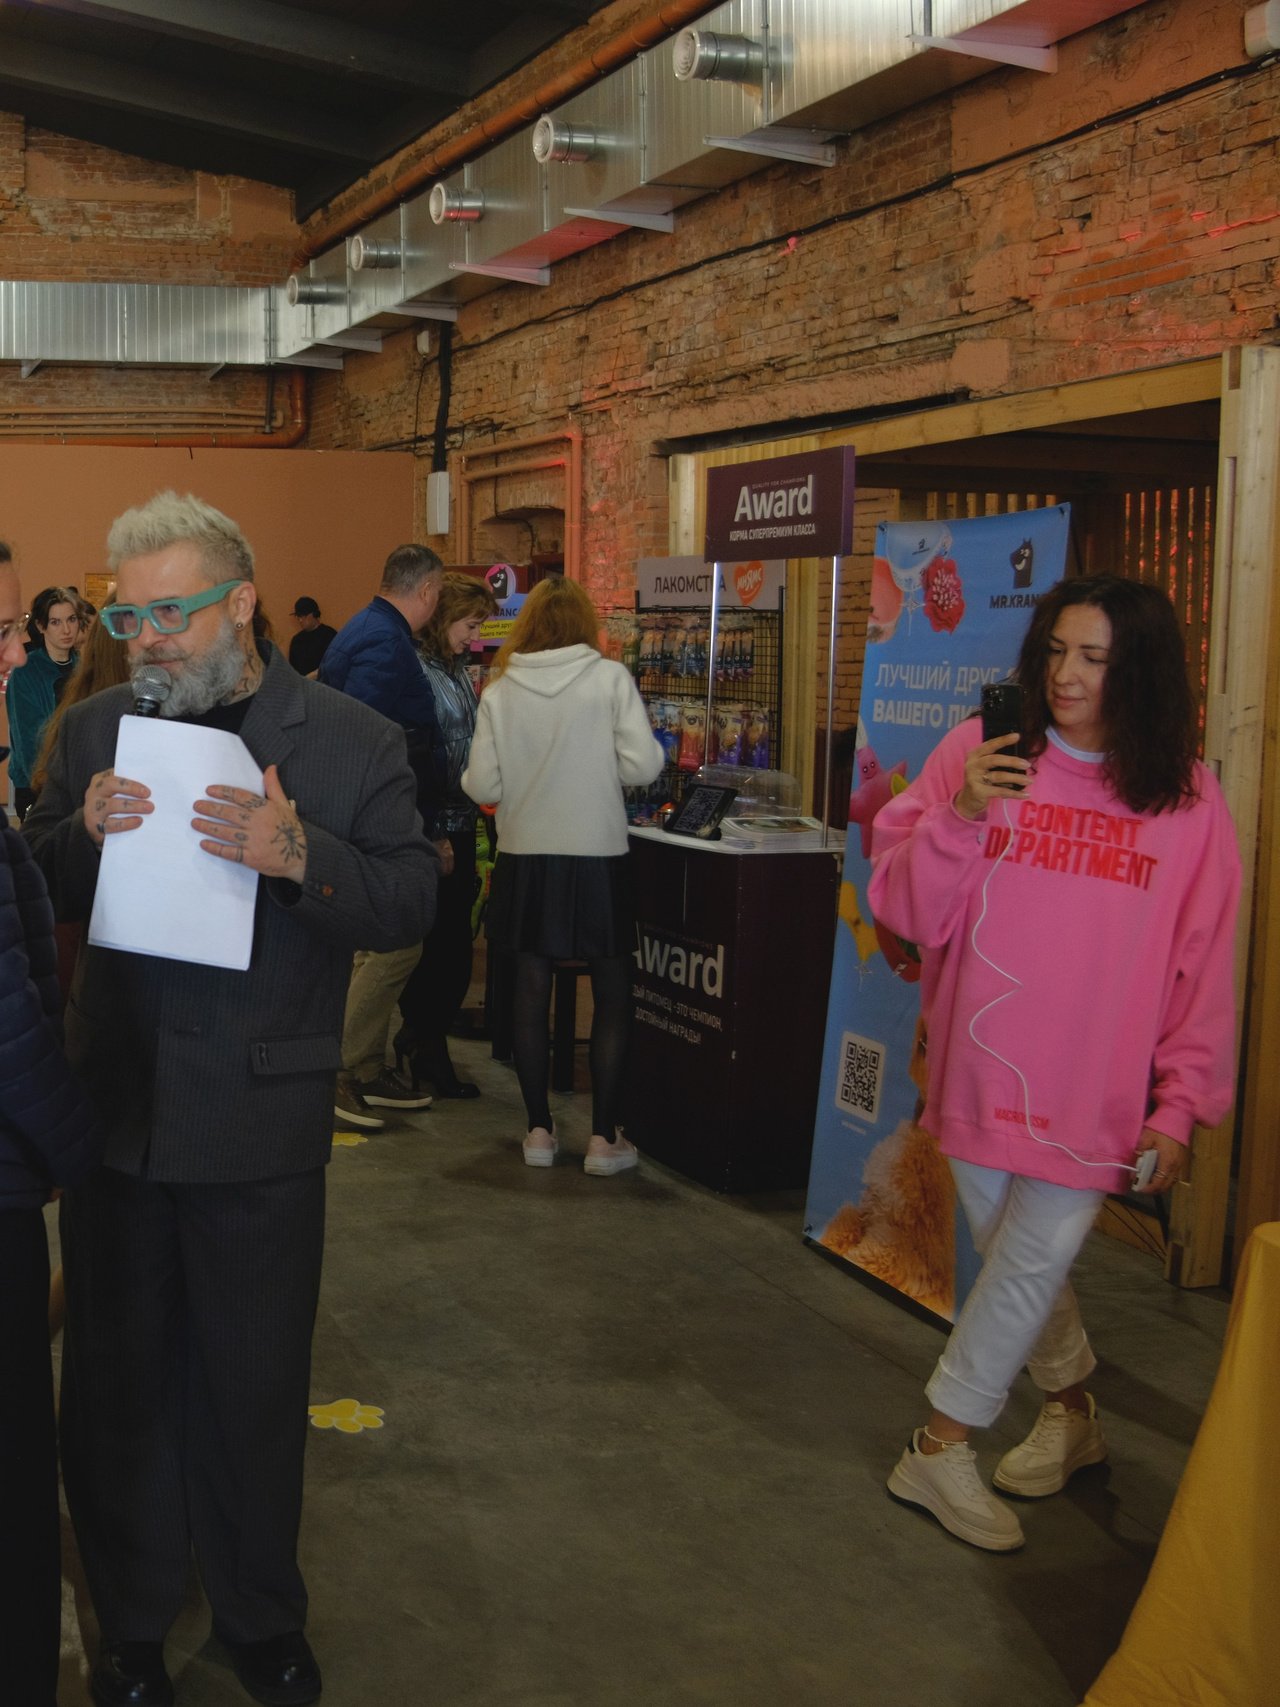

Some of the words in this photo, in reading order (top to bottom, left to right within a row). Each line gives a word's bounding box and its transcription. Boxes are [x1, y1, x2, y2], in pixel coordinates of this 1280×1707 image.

[734, 474, 813, 522] Award
[729, 529, 748, 541] КОРМА
[749, 526, 793, 540] СУПЕРПРЕМИУМ
[793, 523, 816, 536] КЛАССА
[654, 574, 727, 594] ЛАКОМСТА
[990, 593, 1041, 609] MR.KRAN
[875, 661, 950, 691] ЛУЧШИЙ
[953, 666, 1001, 697] ДРУГ
[872, 699, 944, 728] ВАШЕГО
[1018, 800, 1144, 848] CONTENT
[983, 826, 1158, 891] DEPARTMENT
[645, 989, 672, 1013] ПИТОМЕЦ
